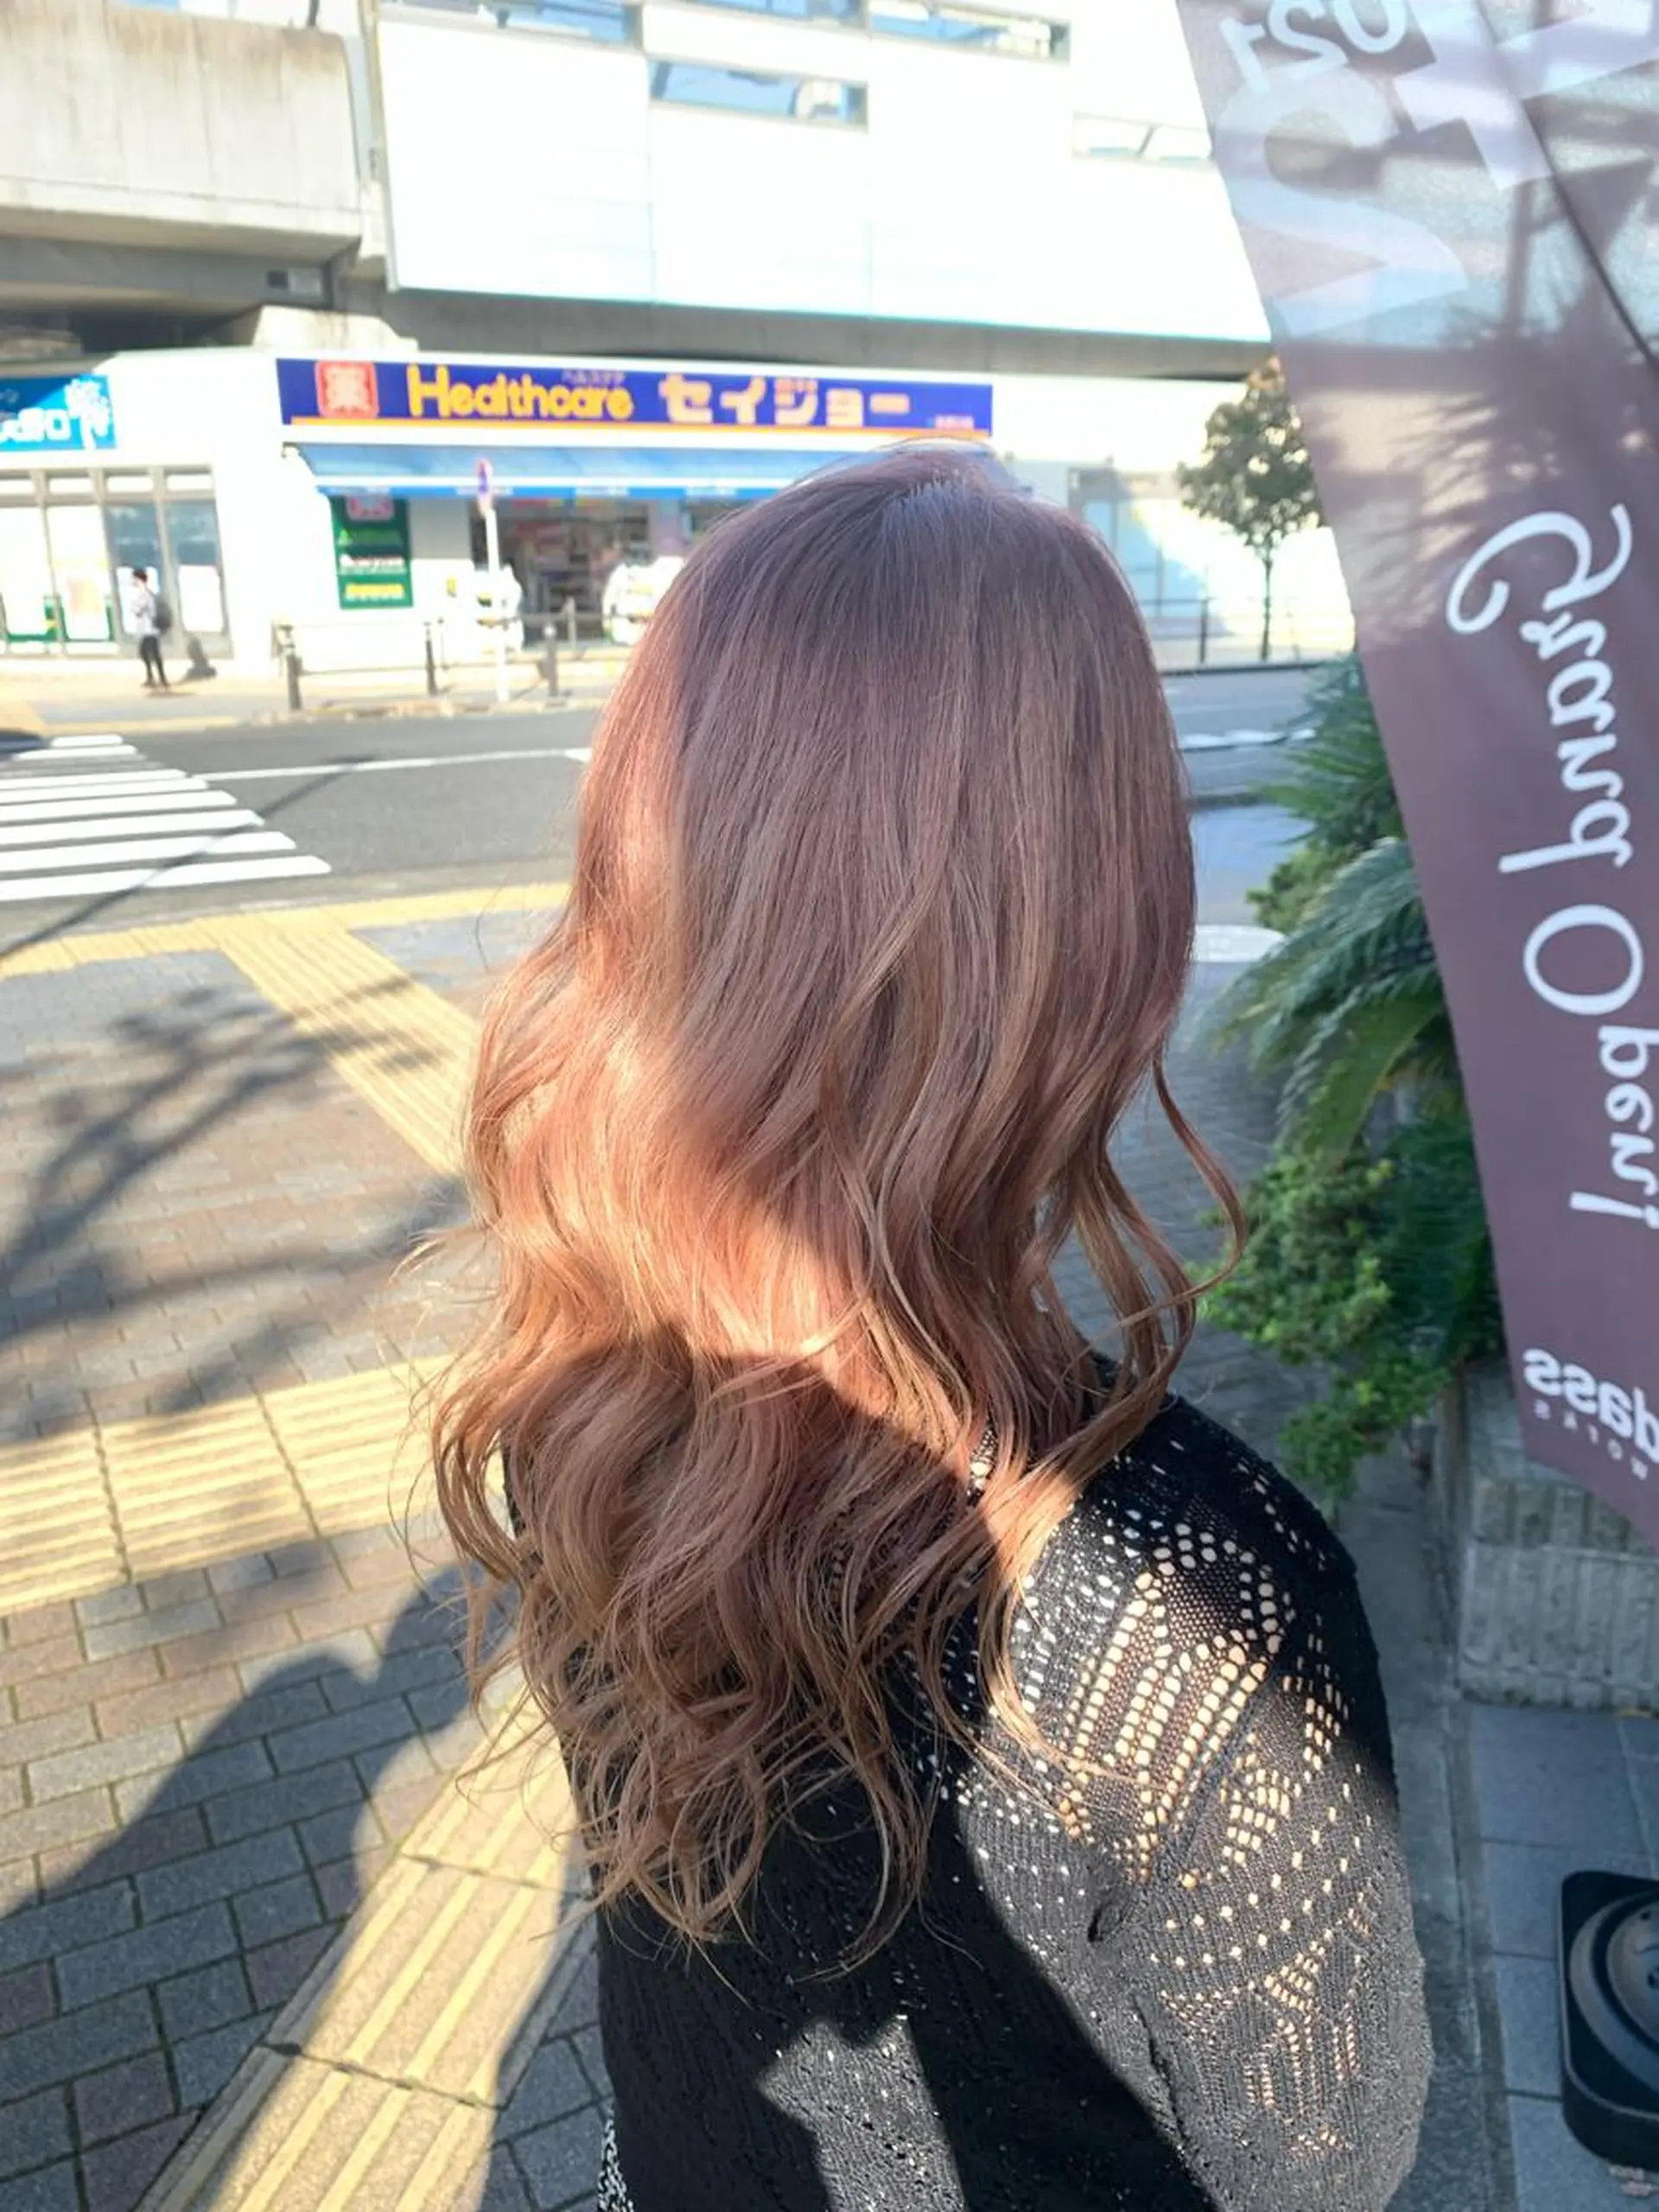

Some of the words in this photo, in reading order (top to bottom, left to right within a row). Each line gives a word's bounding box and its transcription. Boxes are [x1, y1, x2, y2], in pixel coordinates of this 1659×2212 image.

[406, 364, 634, 420] Healthcare
[658, 372, 911, 426] セイジョー
